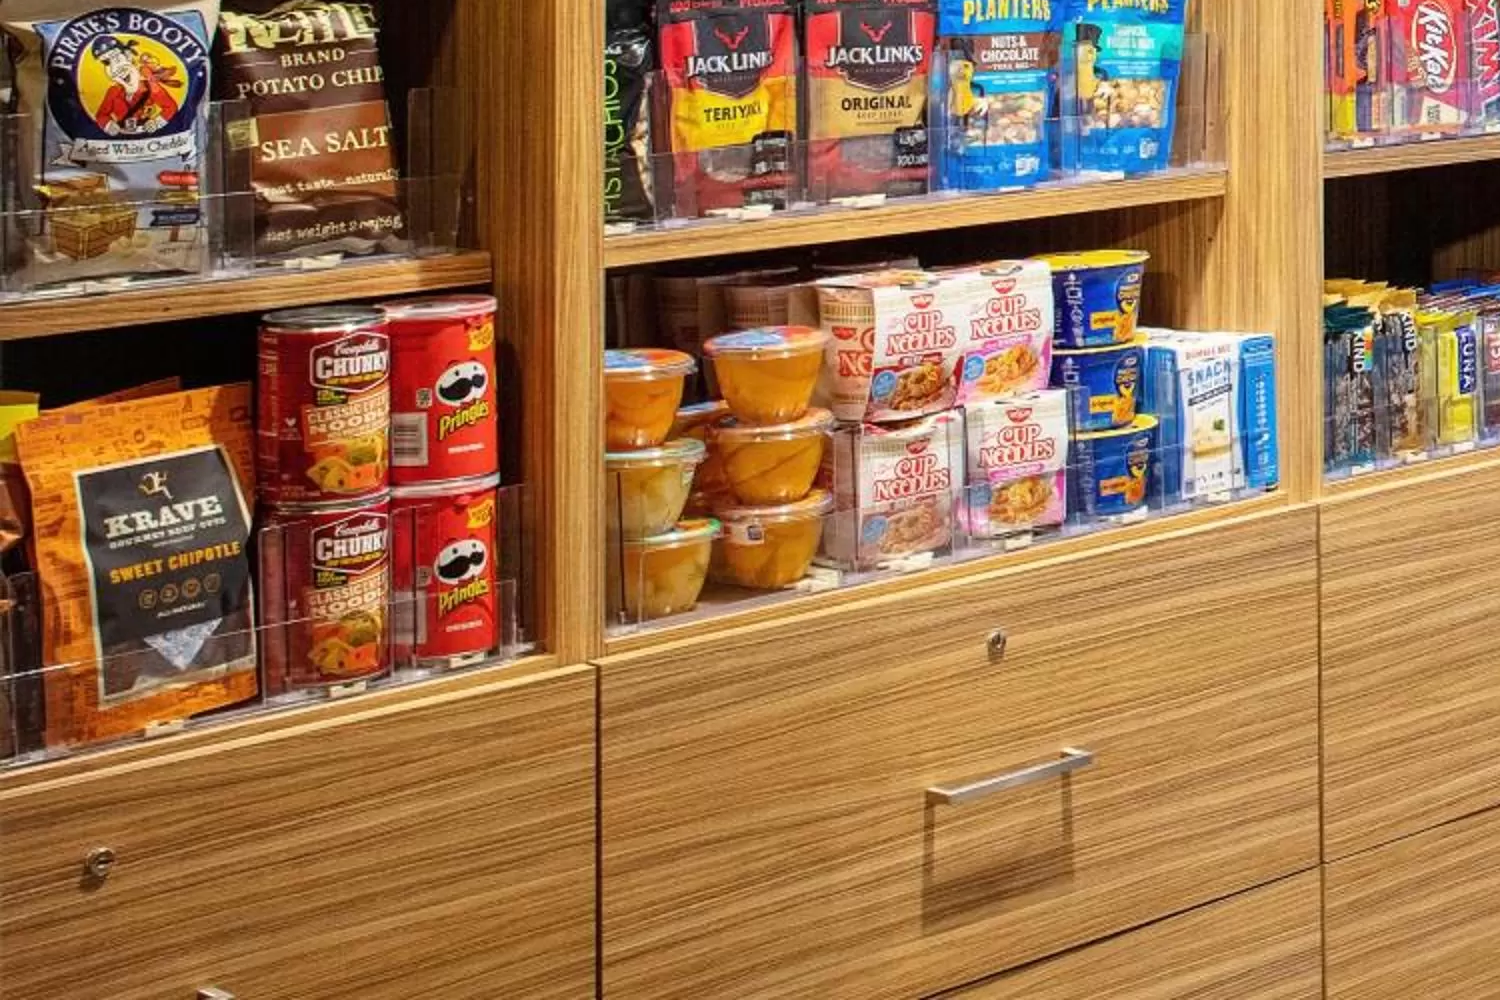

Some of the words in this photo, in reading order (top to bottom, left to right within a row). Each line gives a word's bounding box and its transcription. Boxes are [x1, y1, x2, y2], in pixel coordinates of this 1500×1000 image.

[52, 11, 121, 71] PIRATE'S
[128, 12, 203, 64] BOOTY
[981, 47, 1041, 63] CHOCOLATE
[279, 47, 346, 69] BRAND
[686, 53, 732, 77] JACK
[825, 46, 875, 68] JACK
[236, 72, 326, 100] POTATO
[330, 65, 385, 88] CHIP
[841, 95, 913, 111] ORIGINAL
[260, 136, 321, 162] SEA
[324, 125, 389, 154] SALT
[903, 310, 943, 333] CUP
[985, 294, 1027, 317] CUP
[885, 325, 957, 357] NOODLES
[968, 307, 1043, 341] NOODLES
[1400, 311, 1418, 351] KIND
[1353, 331, 1365, 372] KIND
[1458, 328, 1475, 394] LUNA
[439, 399, 489, 441] Pringles
[999, 423, 1044, 446] CUP
[895, 454, 938, 479] CUP
[978, 438, 1056, 470] NOODLES
[872, 468, 950, 503] NOODLES
[103, 494, 223, 539] KRAVE
[109, 558, 164, 585] SWEET
[167, 540, 242, 571] CHIPOTLE
[439, 577, 488, 618] Pringles
